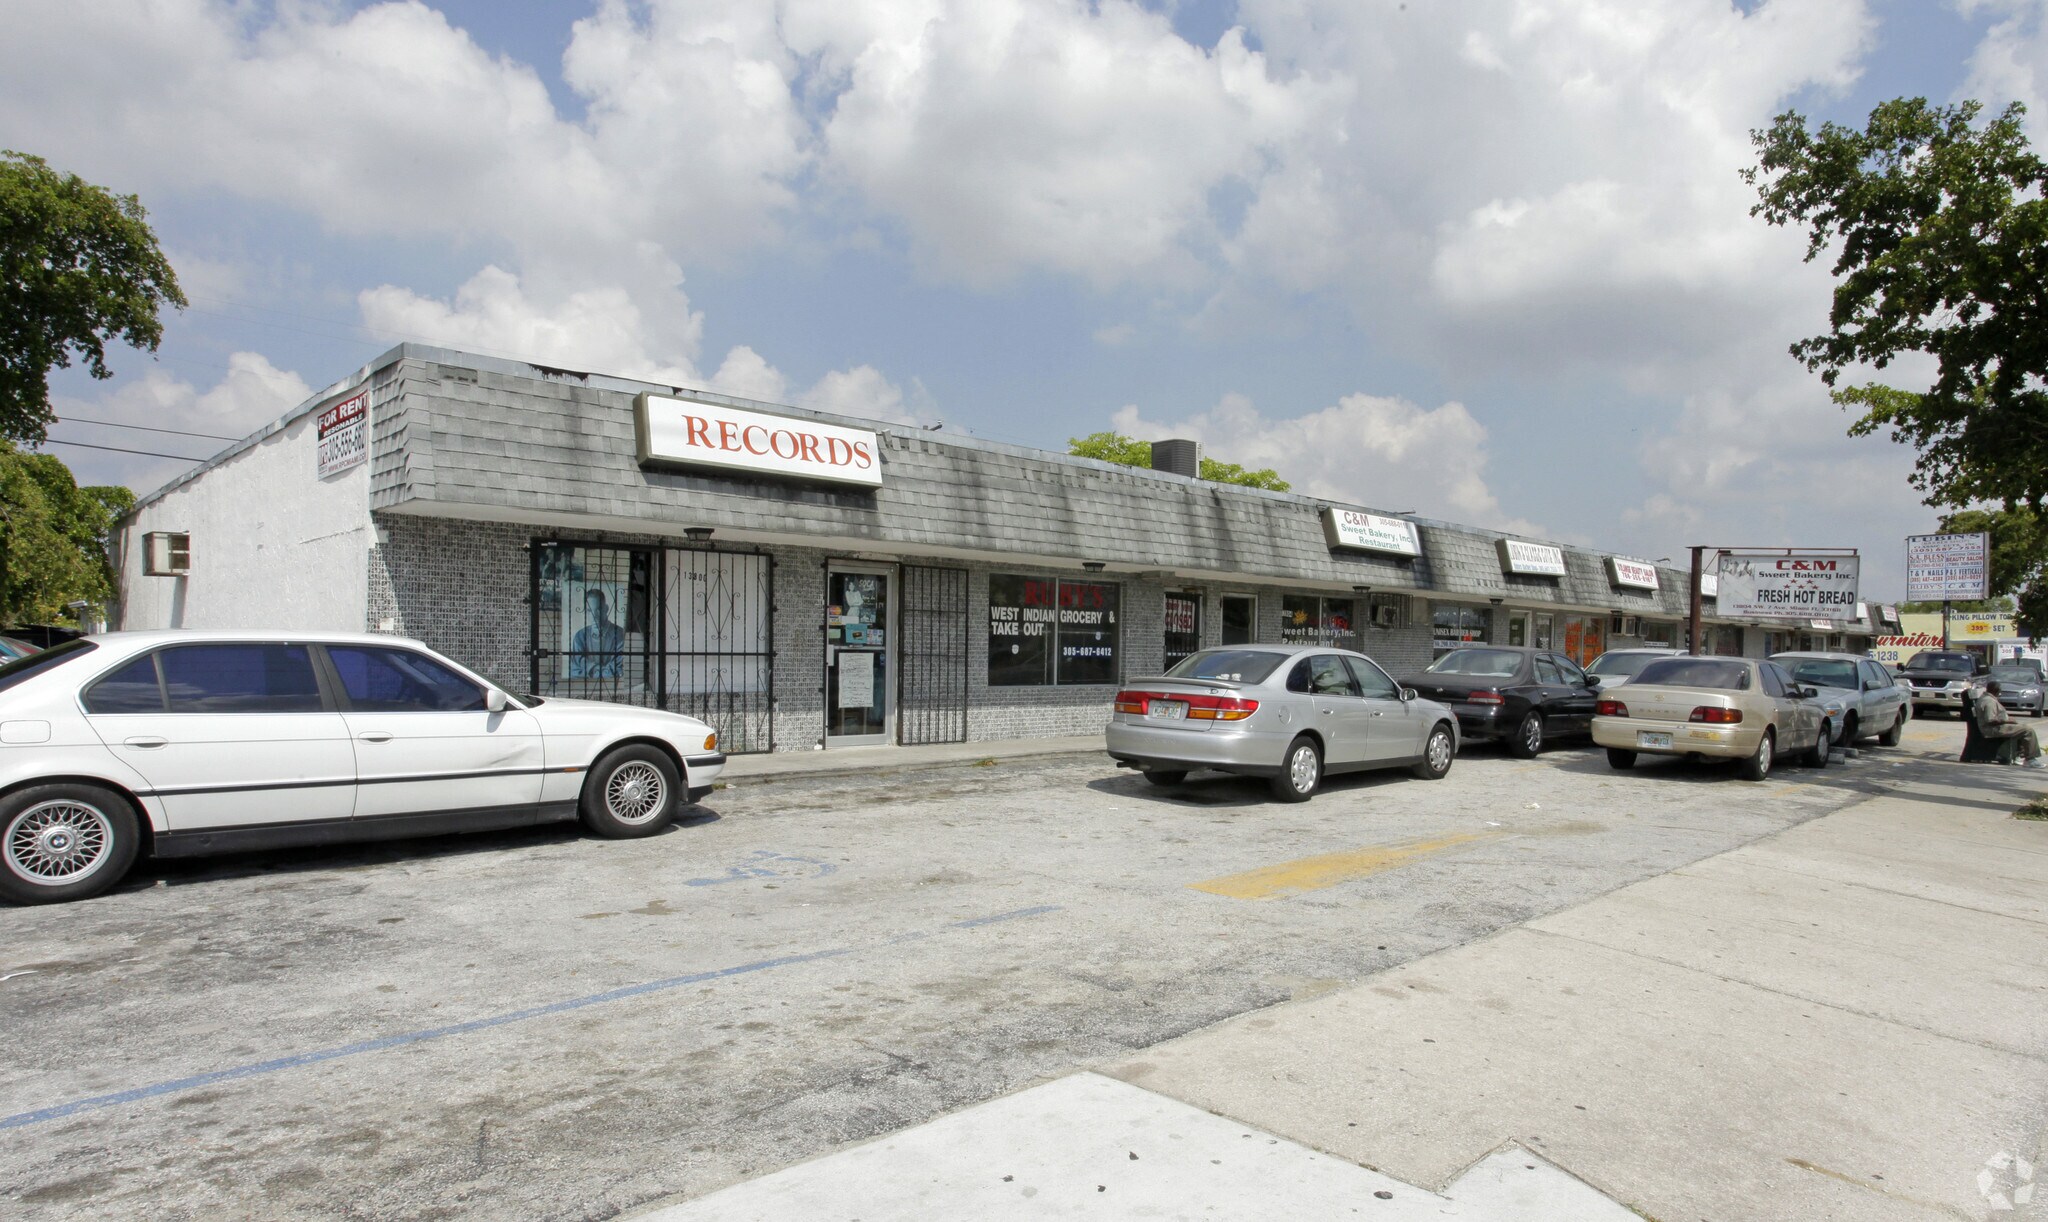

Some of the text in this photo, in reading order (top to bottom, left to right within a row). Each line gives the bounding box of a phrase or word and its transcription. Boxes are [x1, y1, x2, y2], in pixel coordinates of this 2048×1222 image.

[318, 393, 368, 431] FOR RENT
[323, 412, 363, 438] RESONABLE
[681, 414, 872, 470] RECORDS
[1344, 511, 1370, 527] C&M
[1341, 523, 1415, 545] Sweet Bakery, Inc.
[1911, 534, 1981, 542] LUBIN'S
[1359, 536, 1402, 550] Restaurant
[1776, 559, 1837, 571] C&M
[1959, 567, 1983, 575] VERTICALS
[1759, 571, 1855, 580] Sweet Bakery Inc.
[1024, 581, 1104, 609] RUBY'S
[1757, 589, 1855, 605] FRESH HOT BREAD
[991, 606, 1115, 624] WEST INDIAN GROCERY &
[1952, 613, 1970, 621] KING
[1972, 613, 1997, 621] PILLOW
[991, 622, 1044, 636] TAKE OUT
[1282, 627, 1306, 636] weet
[1876, 632, 1945, 648] urniture
[1063, 646, 1112, 657] 305-687-6412
